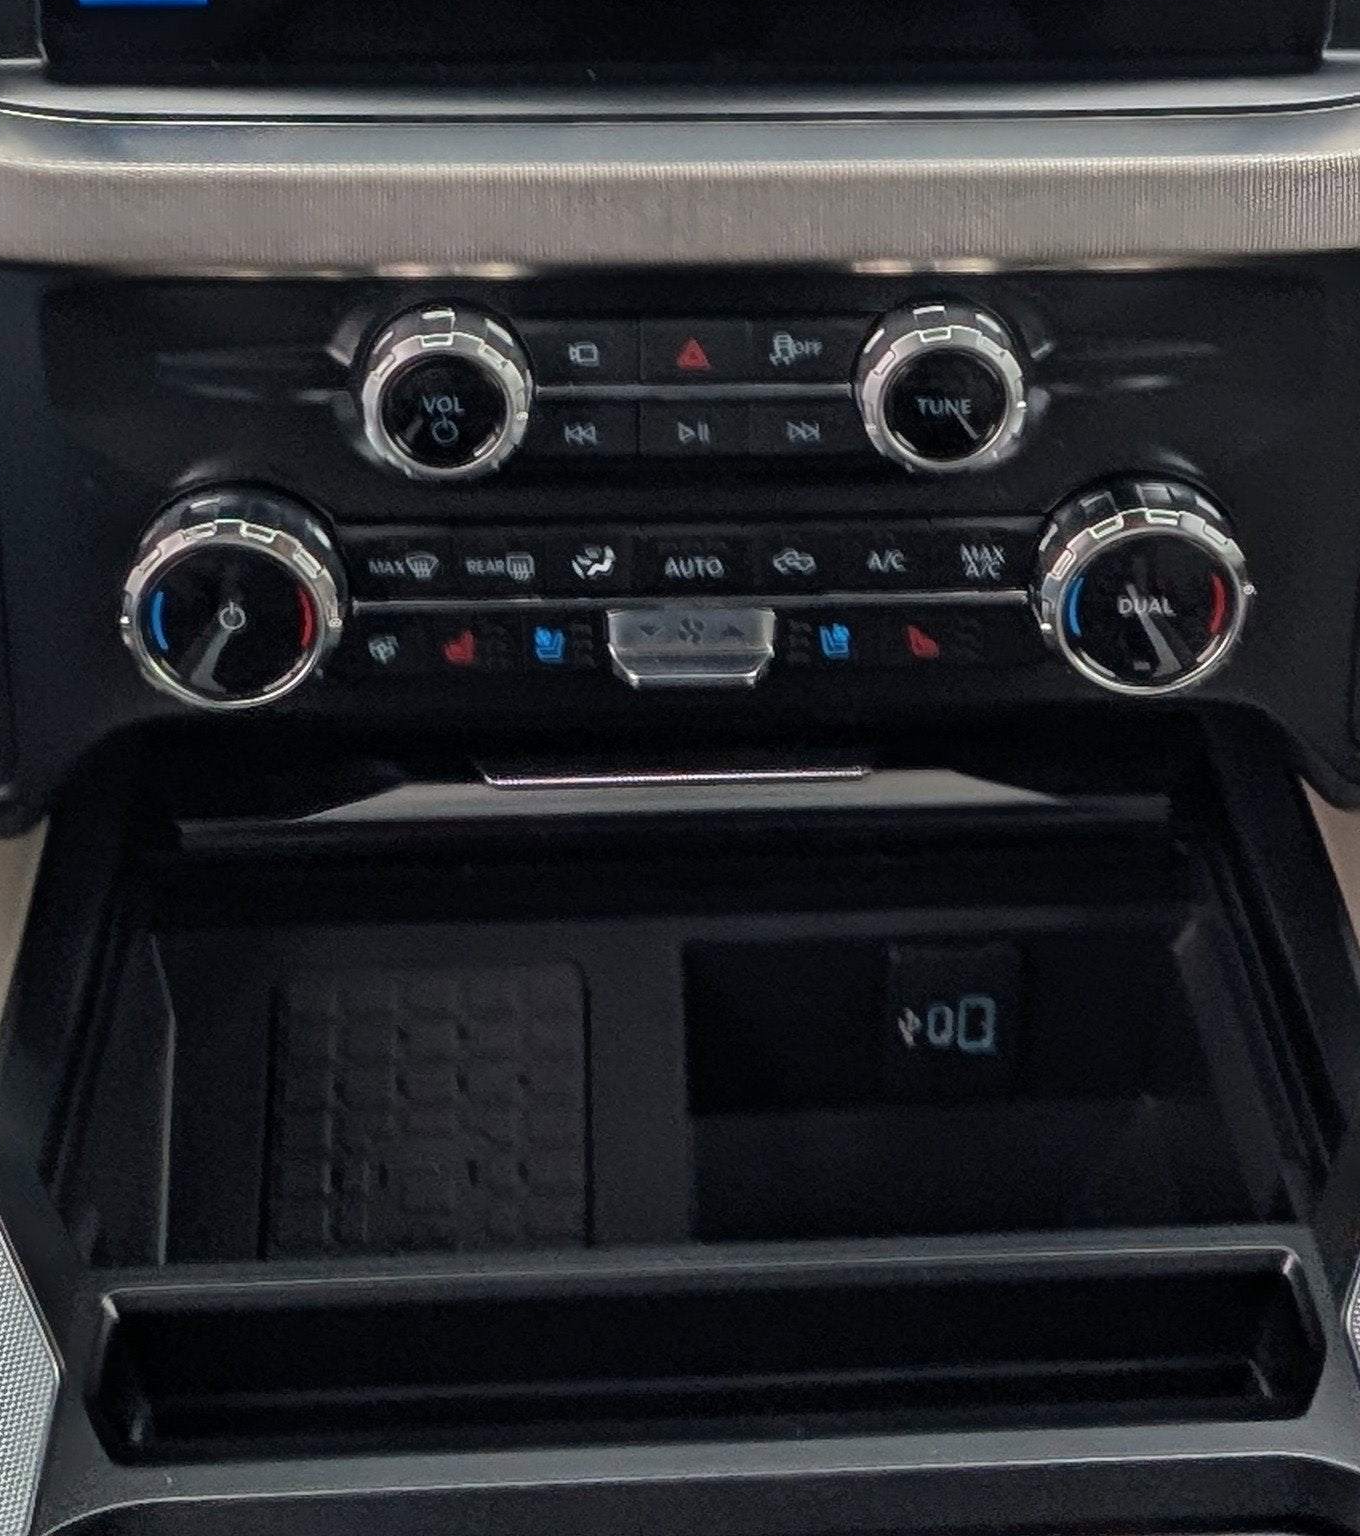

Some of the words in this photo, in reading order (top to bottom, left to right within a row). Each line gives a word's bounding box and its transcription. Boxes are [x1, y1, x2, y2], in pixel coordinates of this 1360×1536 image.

[422, 396, 464, 414] VOL
[918, 397, 972, 416] TUNE
[664, 556, 723, 579] AUTO
[867, 549, 906, 574] A/C
[1118, 595, 1176, 616] DUAL
